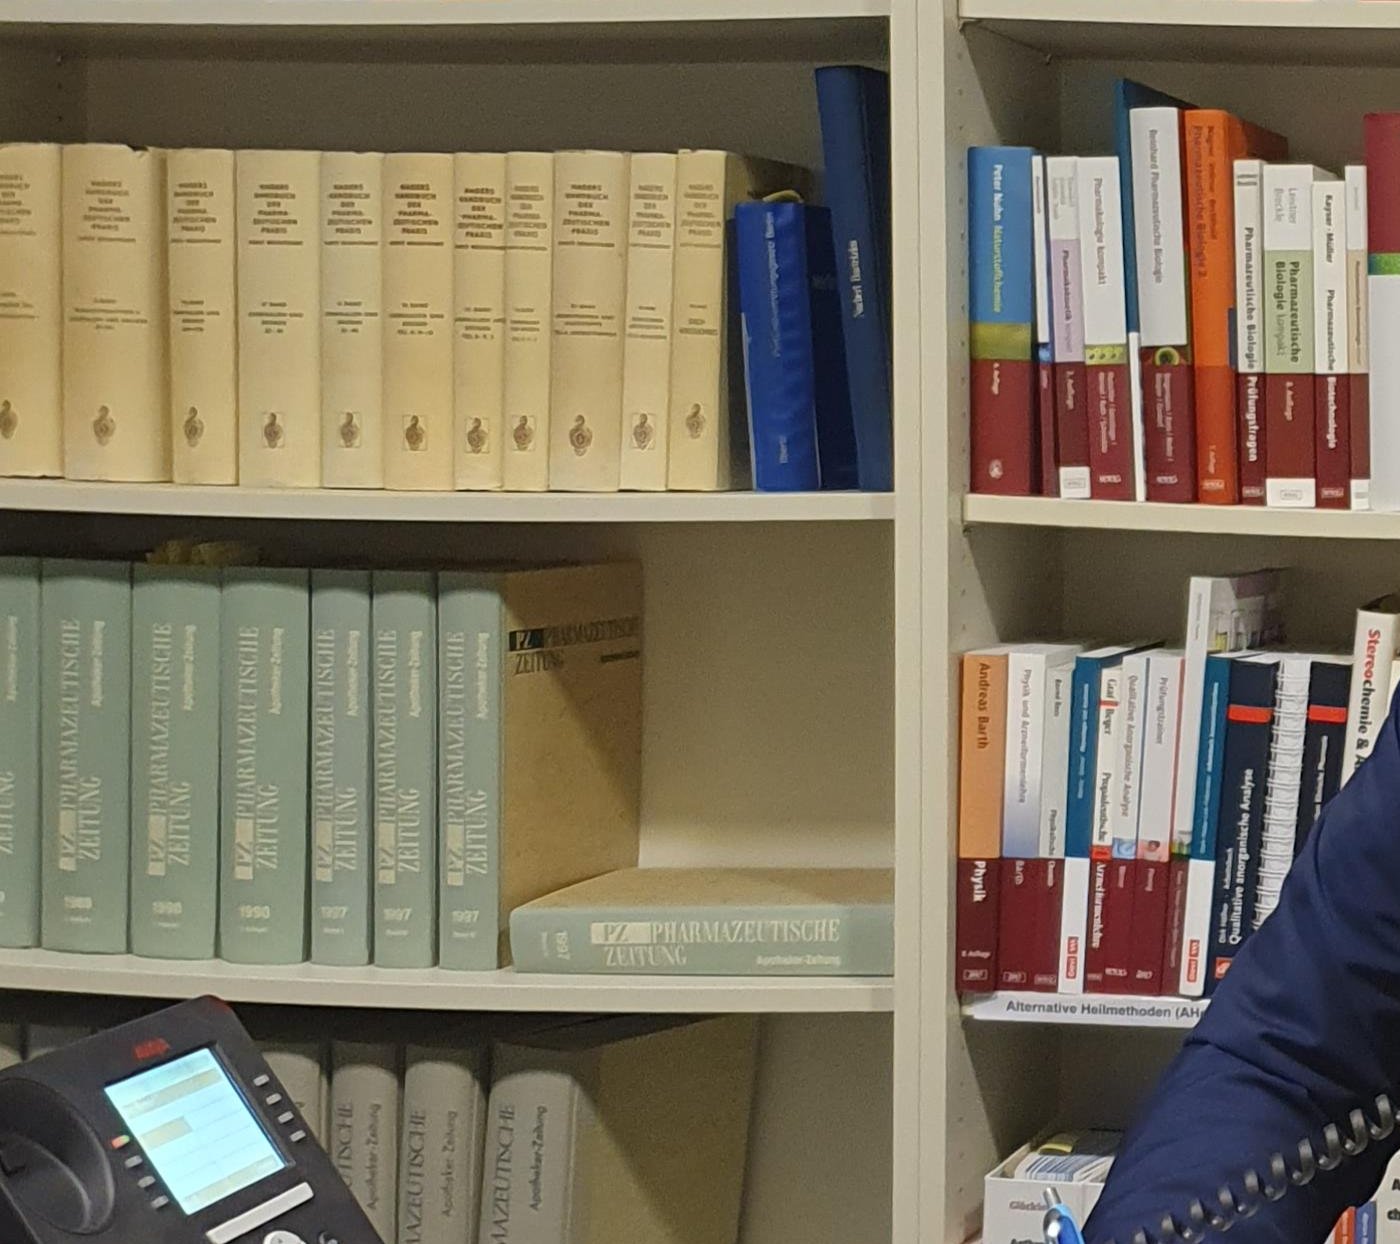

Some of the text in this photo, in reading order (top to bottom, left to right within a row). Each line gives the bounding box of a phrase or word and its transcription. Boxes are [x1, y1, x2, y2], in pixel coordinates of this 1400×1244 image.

[1151, 172, 1164, 246] Pharmazeutische
[1153, 249, 1165, 283] Biologie
[1244, 228, 1260, 462] Pharmazeutische Biologie Prüfungsfragen
[1273, 262, 1288, 357] Biologie kompakt
[1288, 261, 1302, 363] Pharmazeutische
[1324, 195, 1340, 450] Kayser Müller Pharmazeutische Biotechnologie
[59, 619, 80, 809] PHARMAZEUTISCHE
[150, 622, 172, 816] PHARMAZEUTISCHE
[235, 627, 259, 818] PHARMAZEUTISCHE
[316, 629, 336, 819] PHARMAZEUTISCHE
[378, 629, 398, 822] PHARMAZEUTISCHE
[446, 632, 466, 824] PHARMAZEUTISCHE
[1018, 669, 1032, 804] Physik und Arzneiformenlehre
[1120, 675, 1139, 817] Qualitative Anorganische Analyse
[1356, 629, 1382, 750] Stereochemie &
[79, 776, 101, 861] ZEITUNG
[168, 781, 191, 866] ZEITUNG
[256, 785, 281, 869] ZEITUNG
[335, 786, 358, 870] ZEITUNG
[398, 788, 421, 873] ZEITUNG
[466, 789, 489, 874] ZEITUNG
[970, 663, 991, 902] Andreas Barth Physik
[1228, 768, 1255, 945] Qualitative anorganische Analyse
[604, 945, 688, 967] ZEITUNG
[651, 919, 841, 944] PHARMAZEUTISCHE
[1006, 1000, 1078, 1015] Alternative
[1081, 1003, 1171, 1018] Heilmethoden
[406, 1109, 427, 1244] AZEUTISCHE
[491, 1104, 516, 1244] AZEUTISCHE
[529, 1105, 548, 1212] Apotheker-Zeitung
